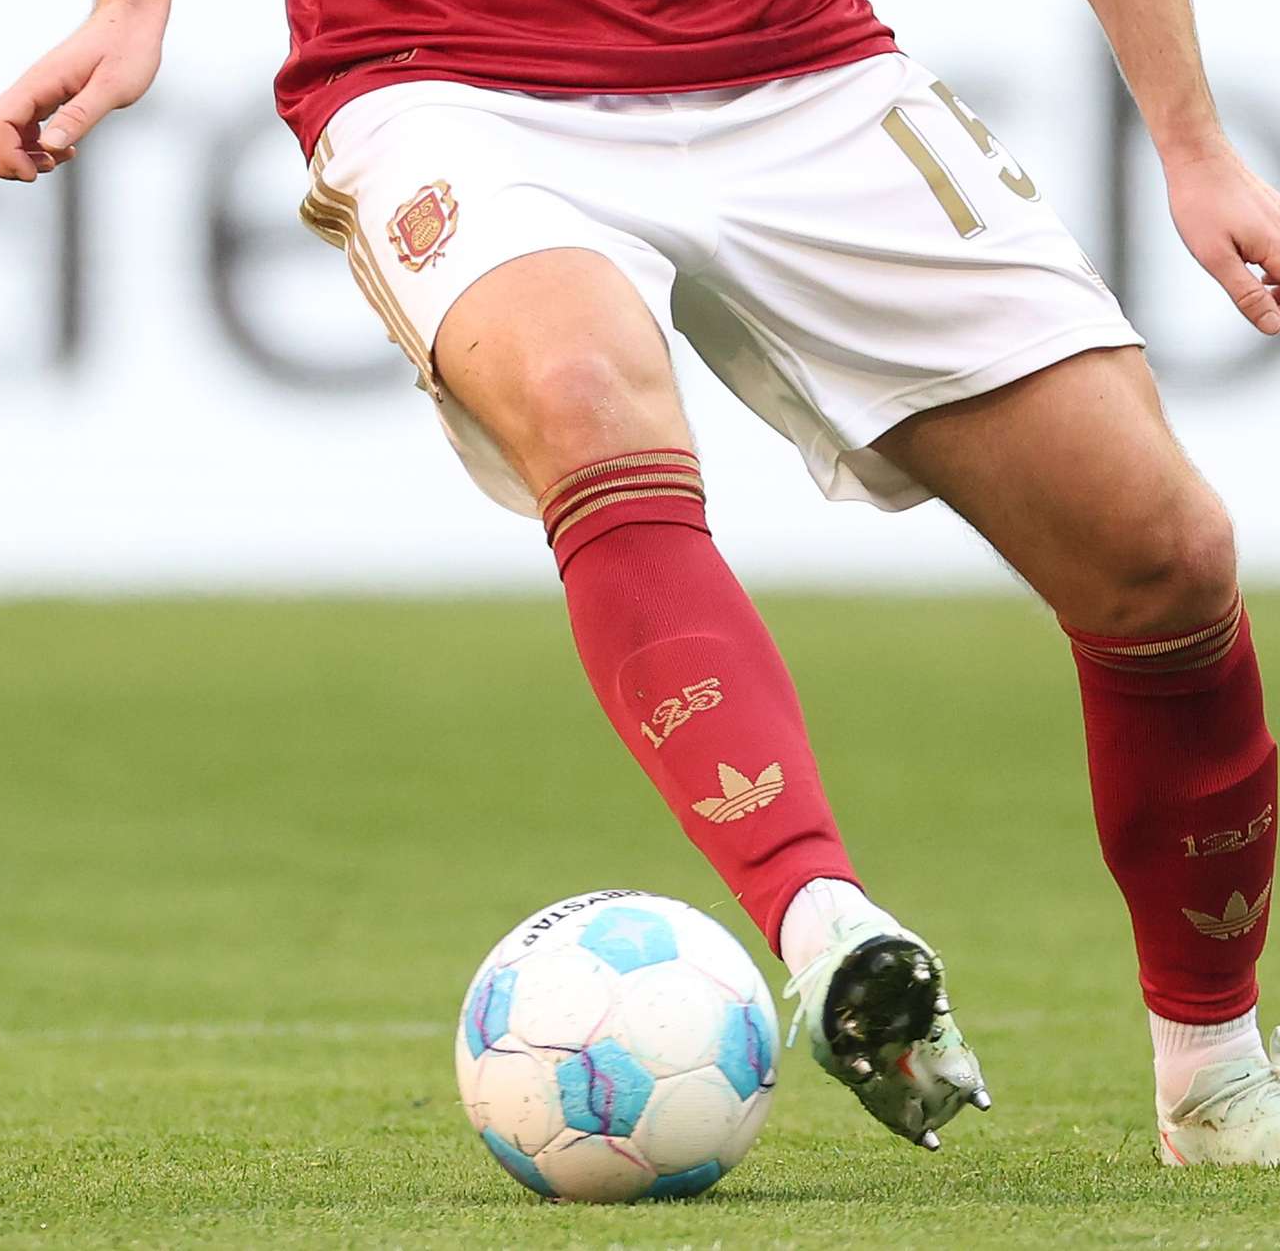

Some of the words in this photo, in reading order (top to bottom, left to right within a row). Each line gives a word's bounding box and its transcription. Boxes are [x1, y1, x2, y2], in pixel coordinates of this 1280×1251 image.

[880, 80, 1042, 240] 15
[404, 196, 434, 234] 125
[640, 677, 724, 749] 125
[1180, 803, 1272, 857] 125
